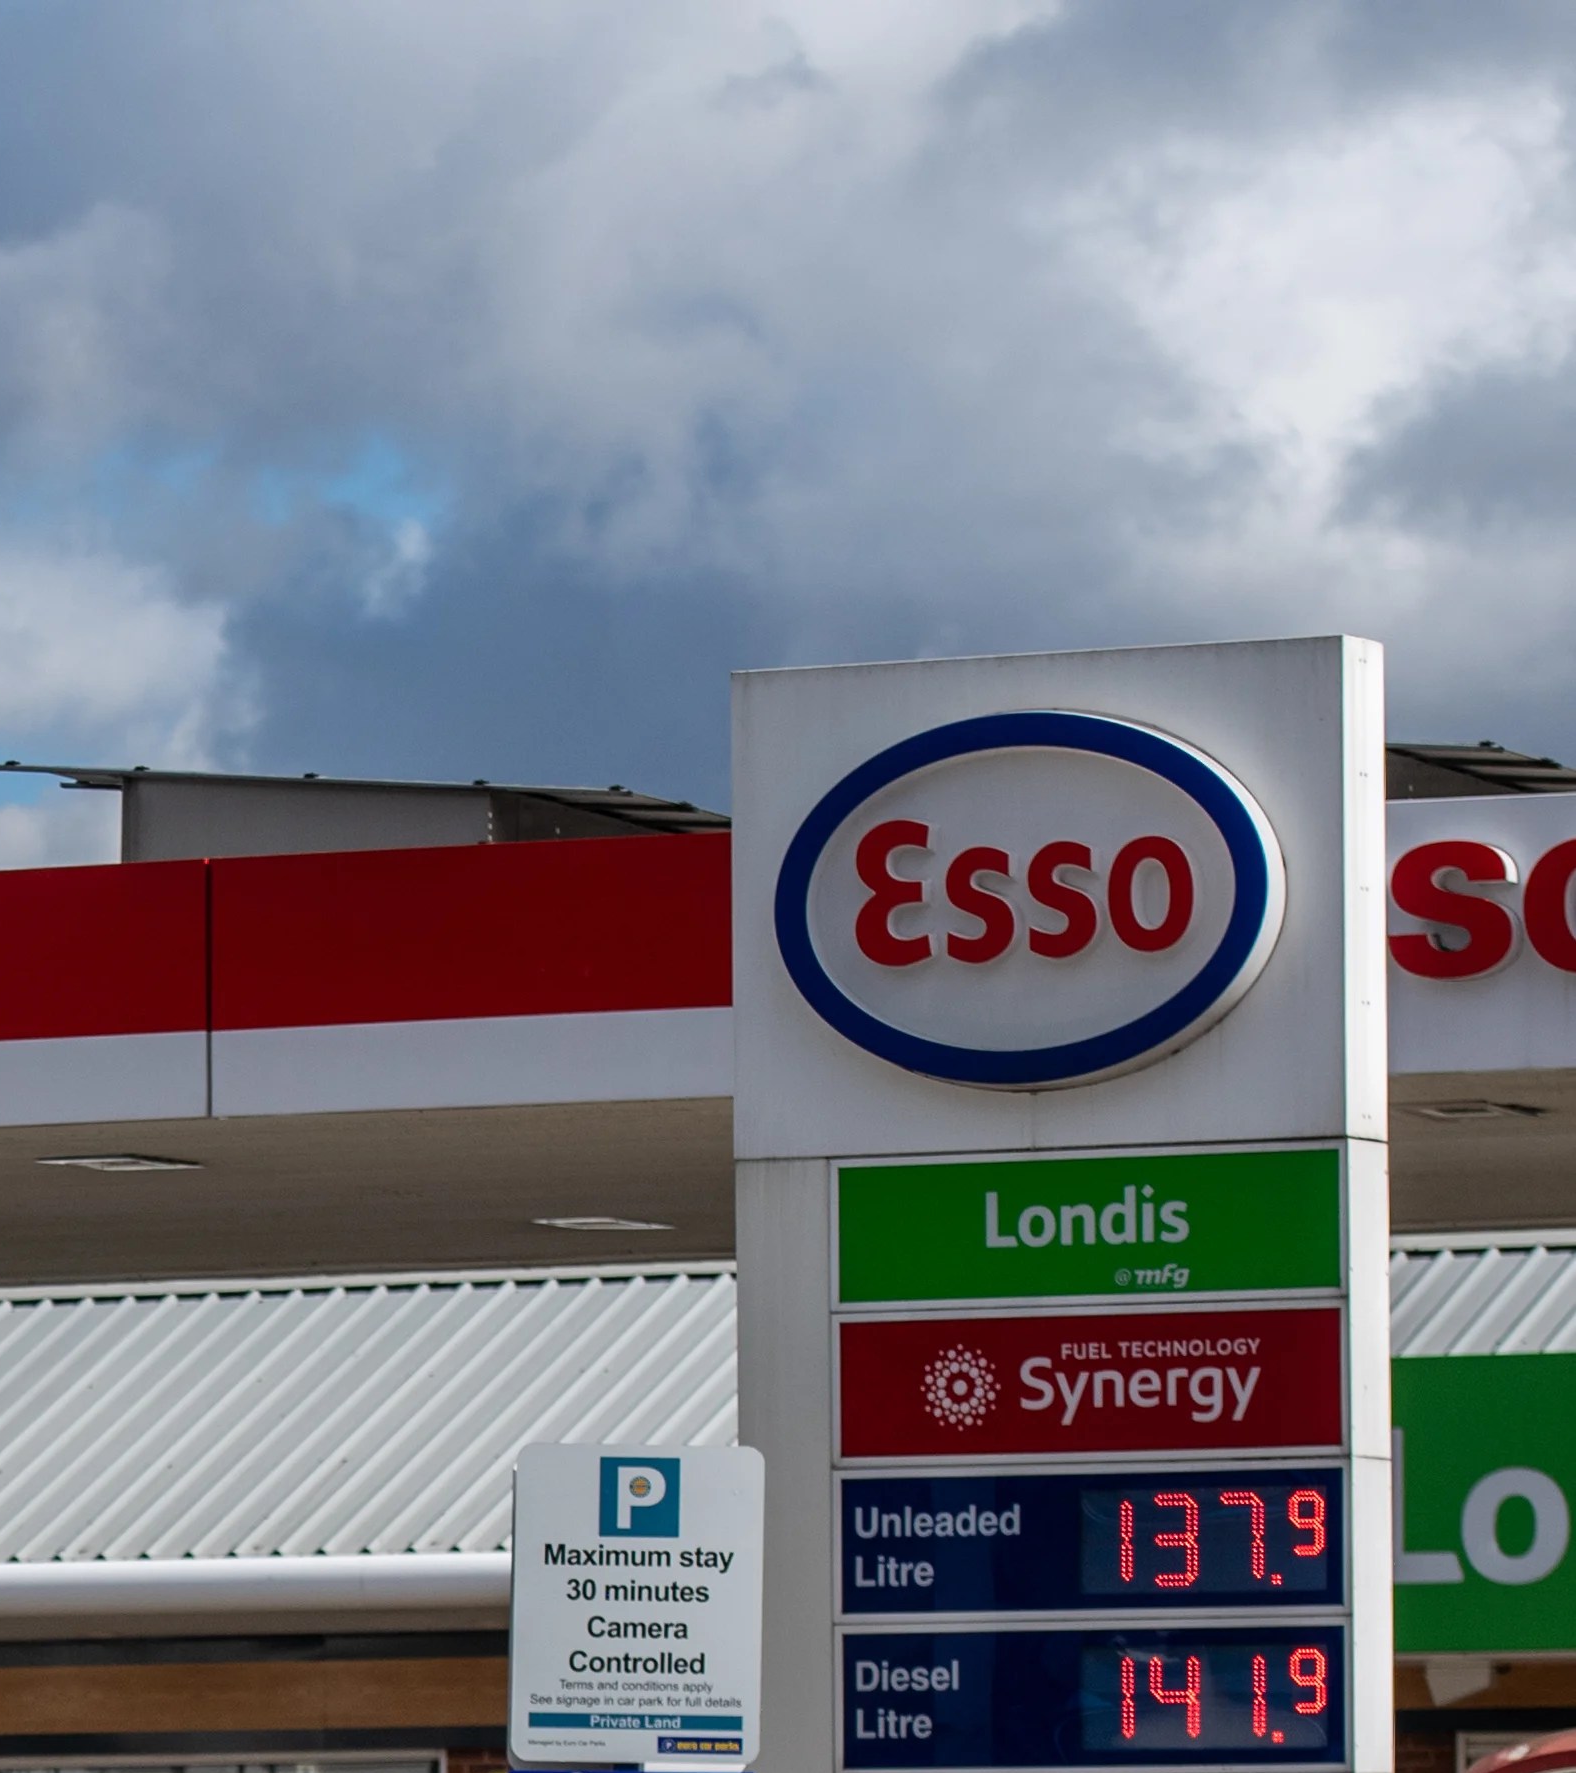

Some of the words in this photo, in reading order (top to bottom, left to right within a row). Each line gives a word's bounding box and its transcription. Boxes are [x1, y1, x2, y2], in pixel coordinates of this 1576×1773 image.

[854, 818, 1195, 968] Esso
[984, 1184, 1190, 1249] Londis
[1134, 1263, 1190, 1289] mfg
[1060, 1342, 1113, 1361] FUEL
[1117, 1338, 1261, 1359] TECHNOLOGY
[1019, 1356, 1261, 1427] Synergy
[854, 1503, 1021, 1539] Unleaded
[1119, 1489, 1327, 1589] 137.9
[543, 1543, 671, 1568] Maximum
[679, 1547, 734, 1574] stay
[854, 1555, 935, 1588] Litre
[566, 1578, 597, 1601] 30
[605, 1580, 710, 1603] minutes
[587, 1615, 689, 1640] Camera
[568, 1650, 706, 1675] Controlled
[855, 1659, 961, 1692] Diesel
[529, 1694, 553, 1706] See
[556, 1694, 601, 1709] signage
[603, 1695, 614, 1706] in
[617, 1697, 635, 1706] car
[638, 1695, 664, 1709] park
[667, 1695, 681, 1706] for
[683, 1695, 700, 1707] full
[704, 1696, 742, 1708] details
[559, 1679, 594, 1692] Terms
[597, 1680, 618, 1691] and
[622, 1680, 679, 1692] conditions
[682, 1681, 713, 1695] apply
[1120, 1646, 1327, 1744] 141.9
[590, 1714, 641, 1728] Private
[646, 1715, 681, 1729] Land
[855, 1707, 934, 1739] Litre
